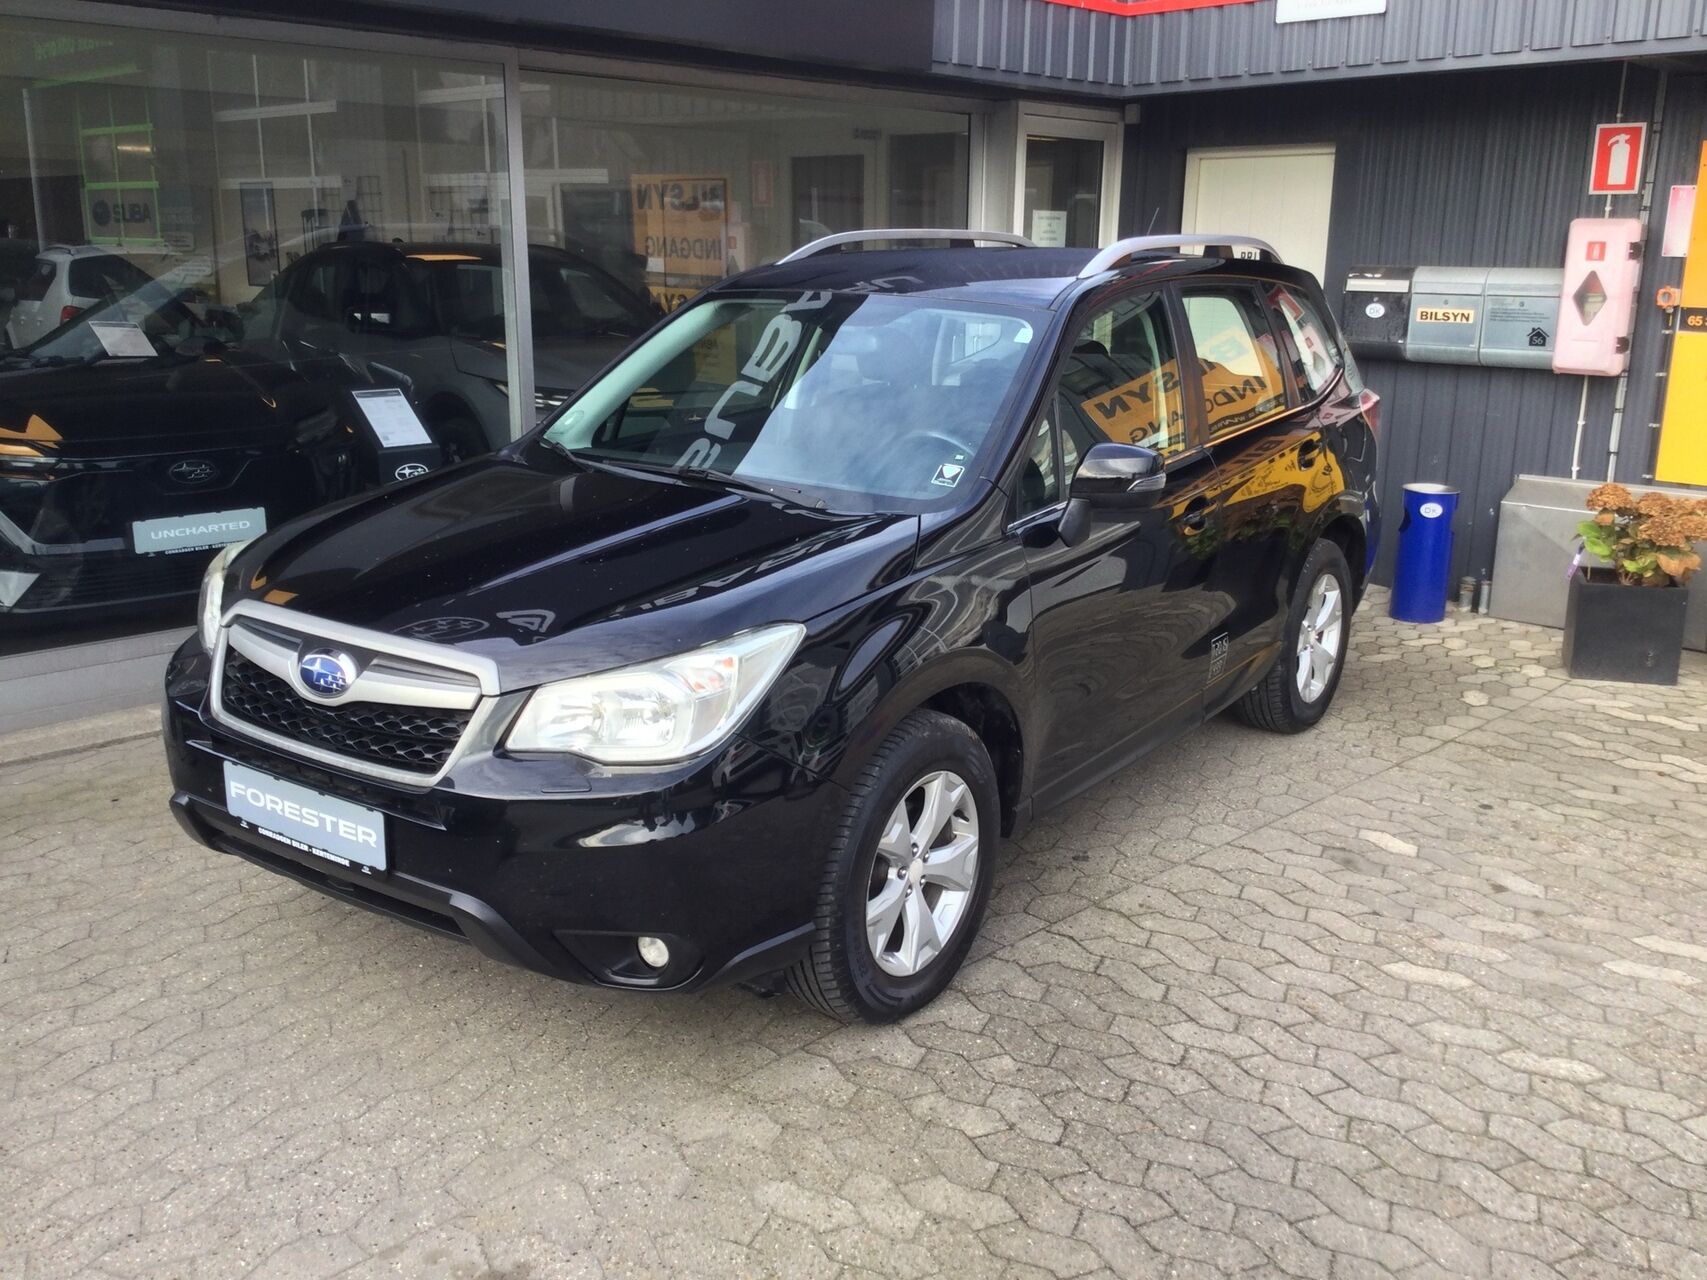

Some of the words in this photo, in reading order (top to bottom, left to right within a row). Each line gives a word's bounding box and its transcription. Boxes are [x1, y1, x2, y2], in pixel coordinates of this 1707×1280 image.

[1419, 310, 1471, 322] BILSYN
[1687, 315, 1703, 326] 65
[1531, 336, 1544, 345] 56
[150, 520, 251, 540] UNCHARTED
[229, 780, 377, 848] FORESTER
